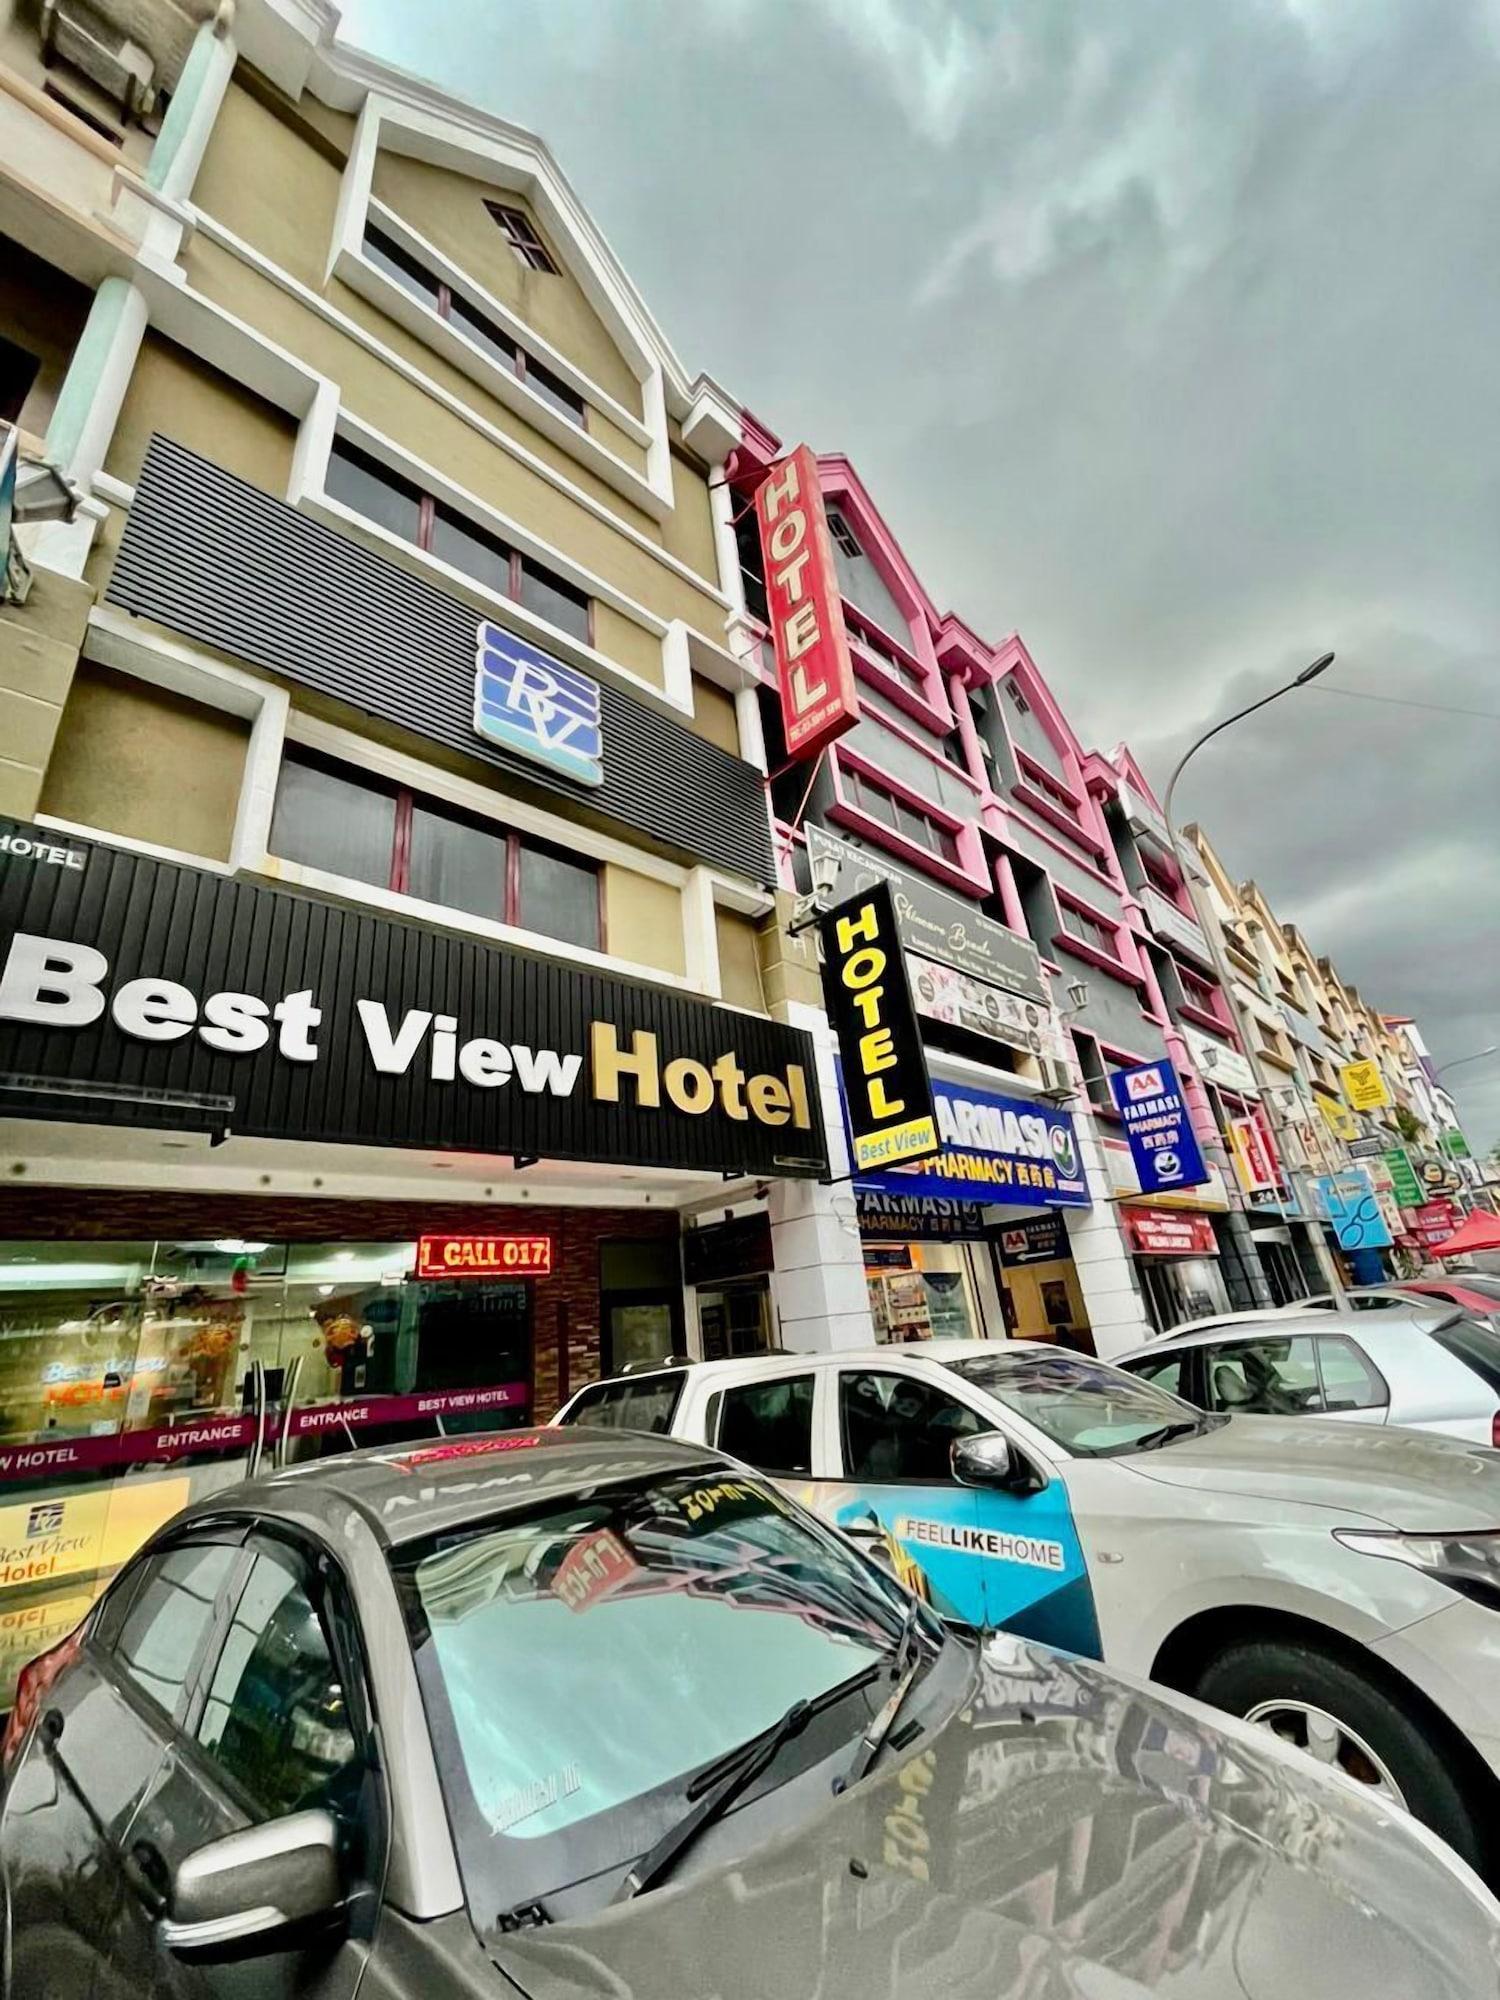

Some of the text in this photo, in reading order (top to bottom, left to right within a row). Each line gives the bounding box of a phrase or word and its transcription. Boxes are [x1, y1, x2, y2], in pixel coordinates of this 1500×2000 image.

[764, 460, 829, 716] HOTEL
[835, 902, 905, 1120] HOTEL
[0, 932, 812, 1130] Best View Hotel
[934, 1094, 1055, 1161] ARMASI
[860, 1127, 931, 1162] Best View
[923, 1152, 1014, 1184] PHARMACY
[855, 1192, 960, 1217] ARMASI
[860, 1214, 925, 1232] HARMACY
[418, 1390, 509, 1412] BEST VIEW HOTEL
[300, 1407, 369, 1428] ENTRANCE
[156, 1424, 243, 1449] ENTRANCE
[16, 1448, 79, 1470] HOTEL
